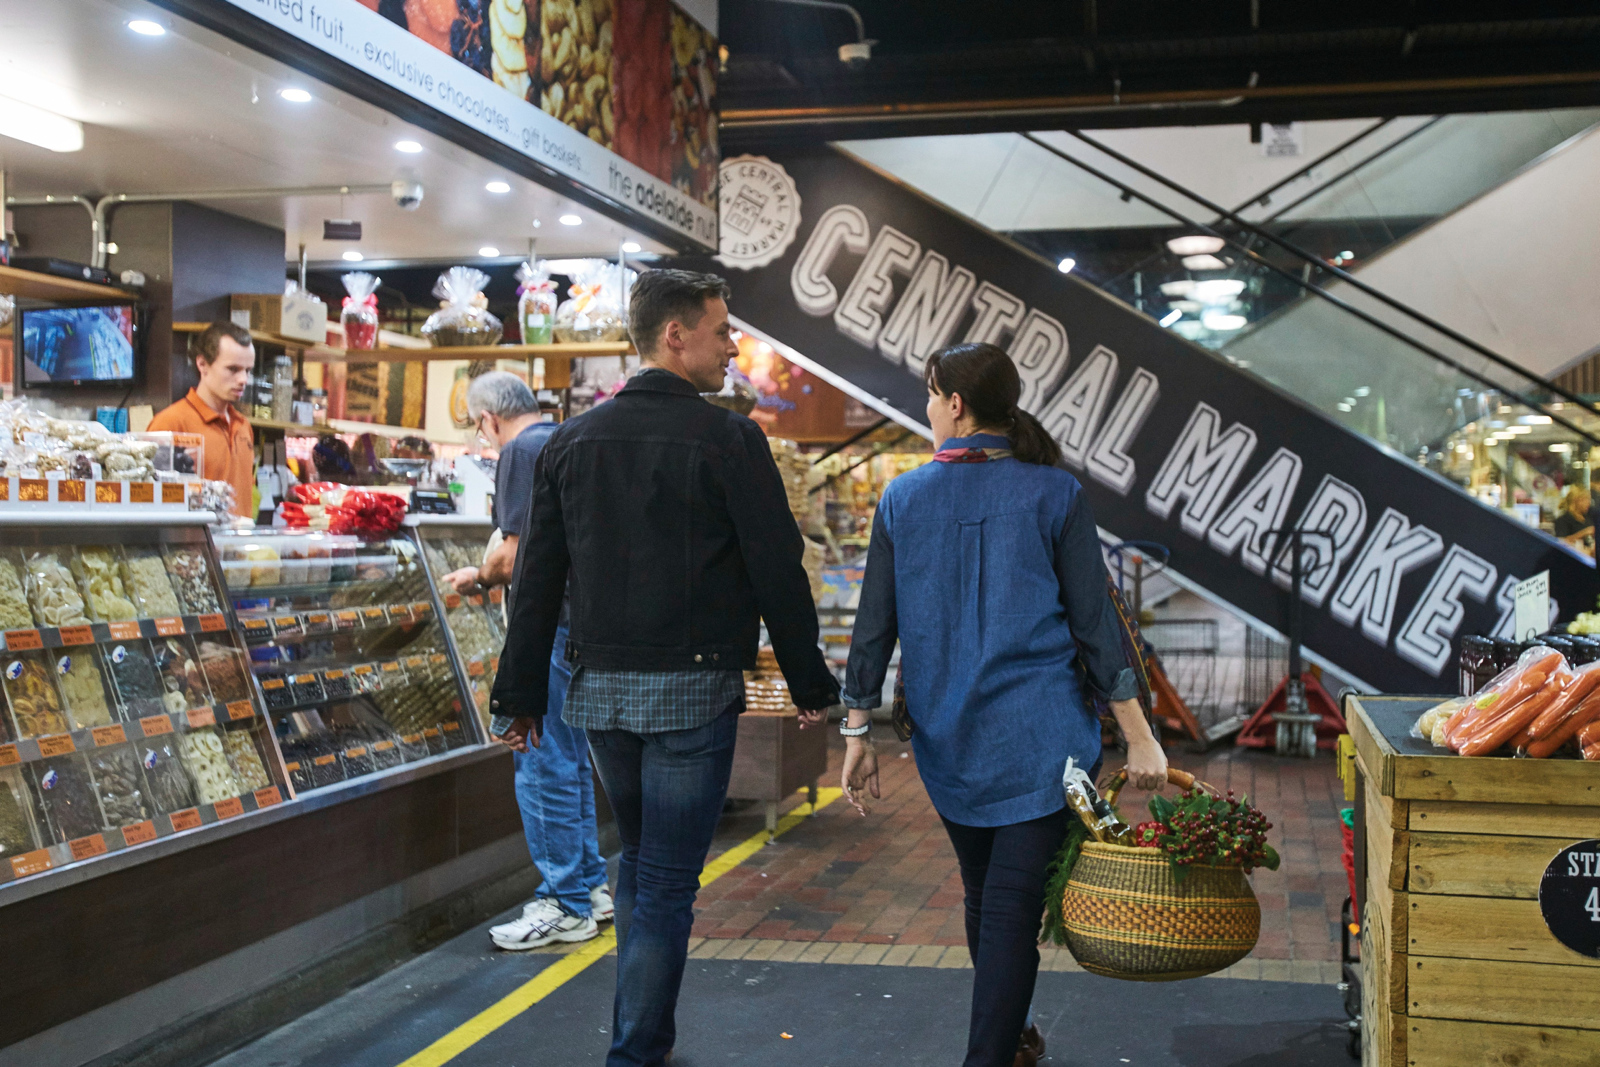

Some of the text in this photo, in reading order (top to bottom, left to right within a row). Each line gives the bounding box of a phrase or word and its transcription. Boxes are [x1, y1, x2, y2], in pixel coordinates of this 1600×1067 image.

[364, 41, 434, 93] exclusive
[521, 126, 541, 148] gift
[608, 161, 633, 199] the
[635, 181, 695, 232] adelaide
[739, 165, 791, 213] CENTRAL
[790, 204, 1161, 498] CENTRAL
